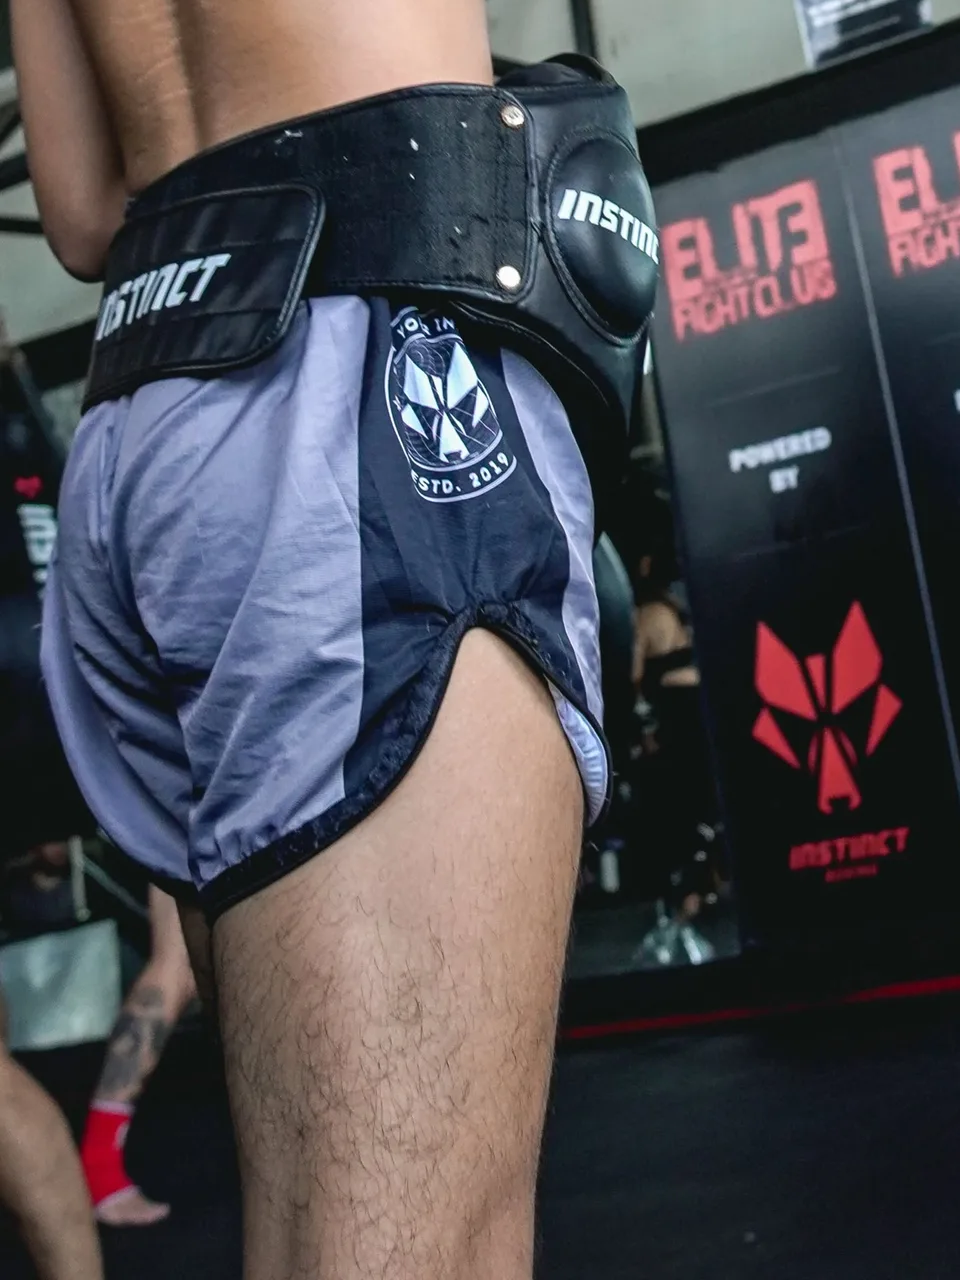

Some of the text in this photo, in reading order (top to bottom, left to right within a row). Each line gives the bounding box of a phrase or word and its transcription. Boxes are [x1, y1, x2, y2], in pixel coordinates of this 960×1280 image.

[557, 188, 660, 265] INSTINC
[661, 180, 829, 300] ELITE
[96, 253, 232, 342] INSTINCT
[468, 452, 510, 489] 2019
[728, 426, 832, 473] POWERED
[768, 465, 800, 493] BY
[789, 825, 910, 870] INSTINCT
